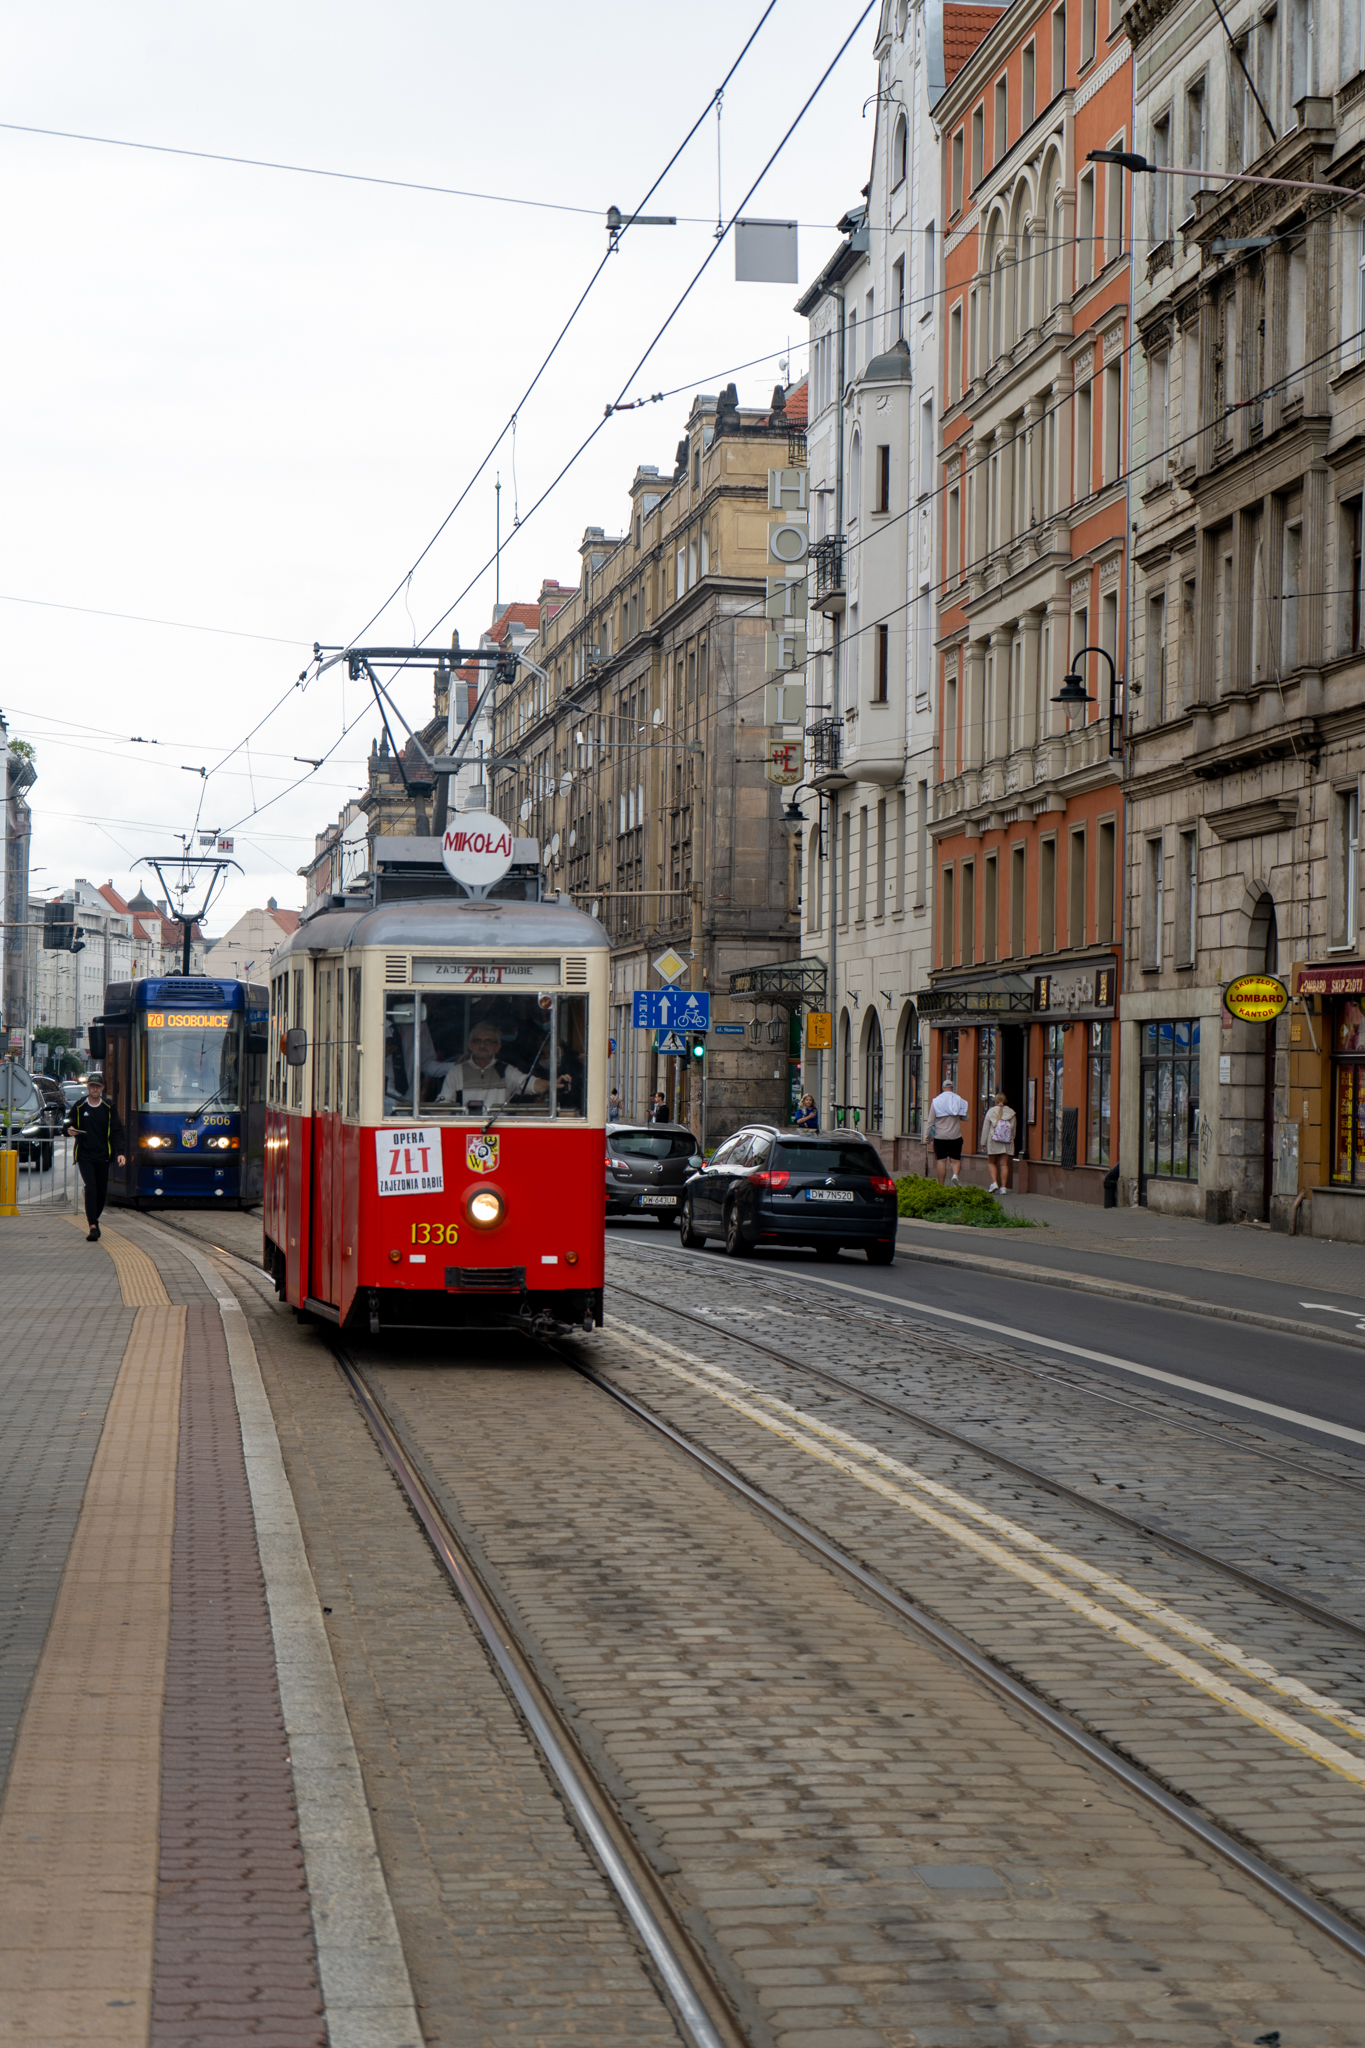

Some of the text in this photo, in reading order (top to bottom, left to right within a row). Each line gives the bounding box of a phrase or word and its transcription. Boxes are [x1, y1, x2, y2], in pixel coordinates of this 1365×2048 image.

[770, 471, 808, 725] HOTEL
[1234, 978, 1279, 991] SKUP ZŁOTA
[1229, 994, 1284, 1003] LOMBARD
[1238, 1007, 1275, 1018] KANTOR
[149, 1014, 229, 1027] 70 OSOBOWICE
[203, 1115, 230, 1126] 2606
[393, 1131, 425, 1145] OPERA
[389, 1146, 431, 1175] ZŁT
[380, 1176, 443, 1192] ZAJEZDNIA DĄBIE
[812, 1190, 824, 1199] DW
[411, 1222, 460, 1245] 1336
